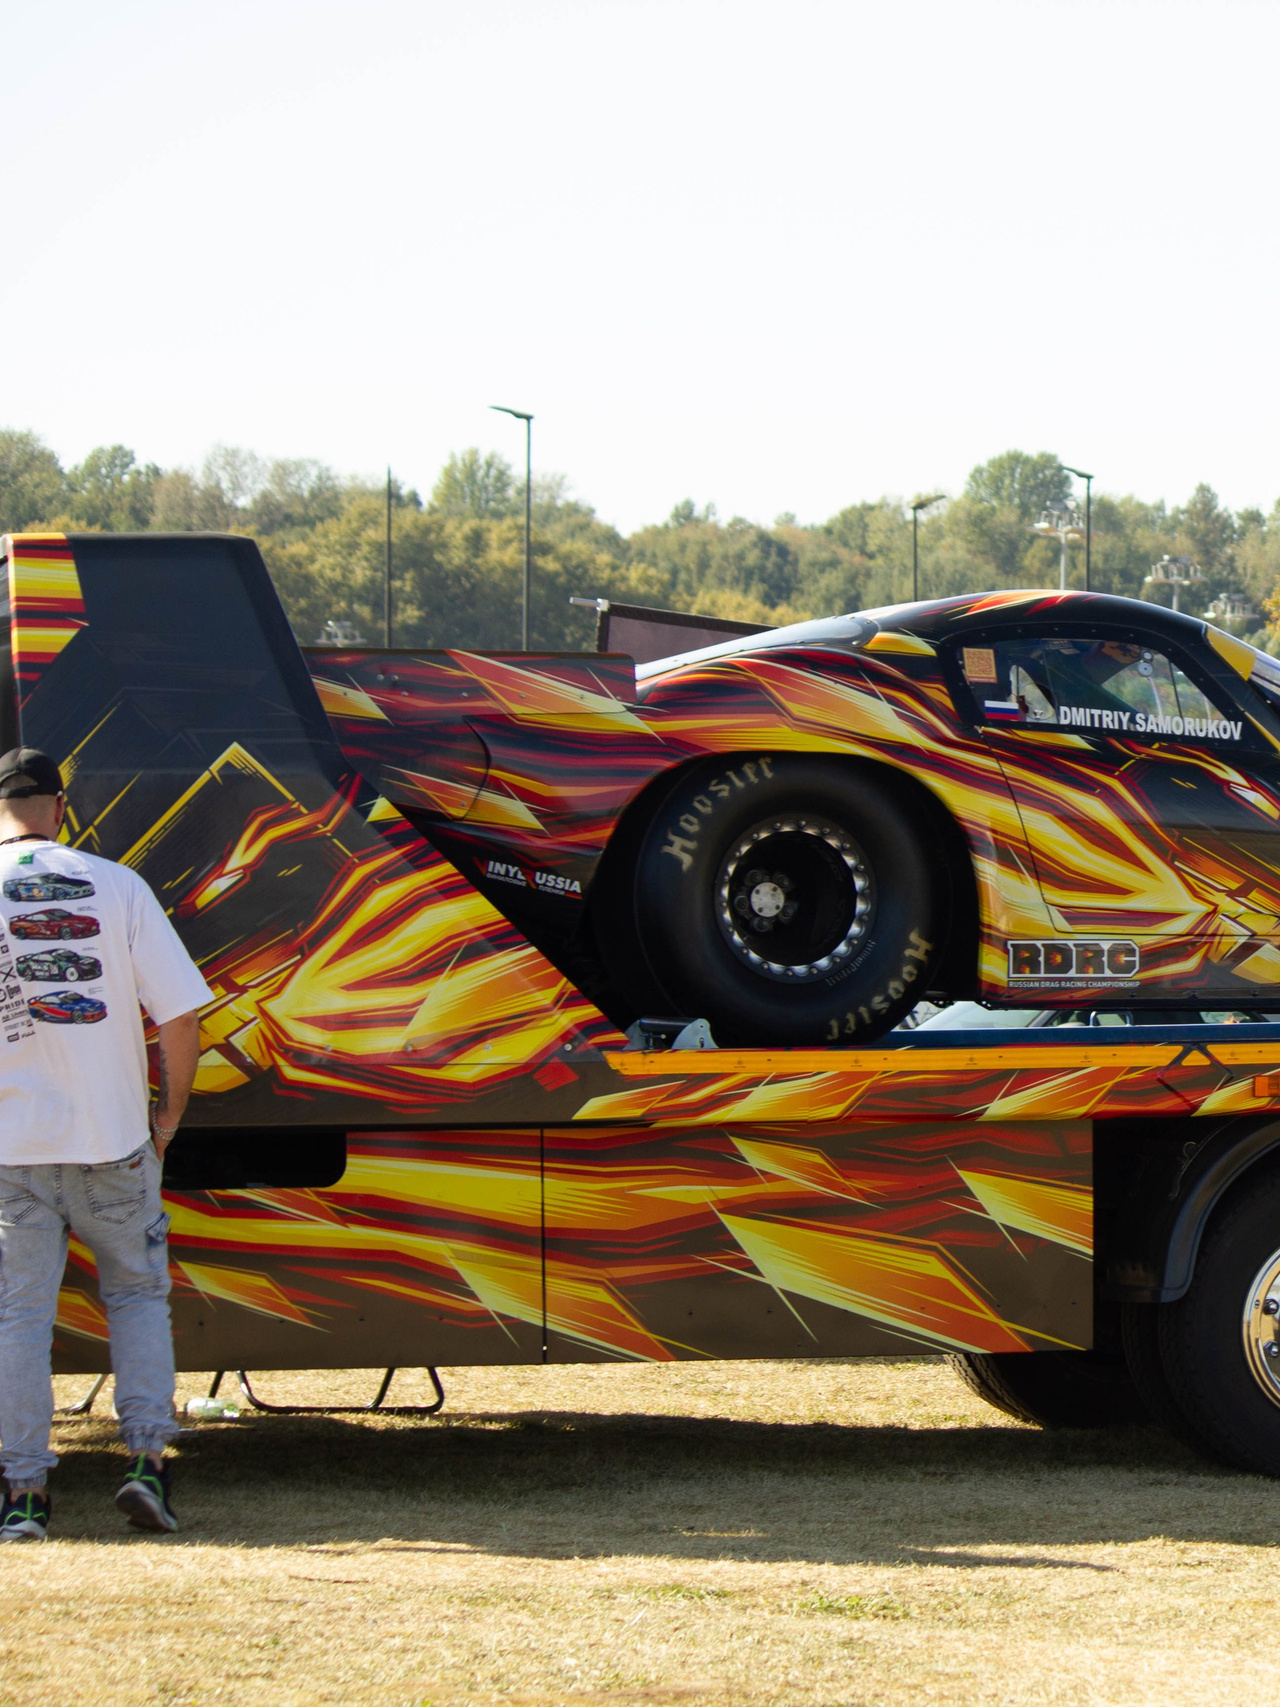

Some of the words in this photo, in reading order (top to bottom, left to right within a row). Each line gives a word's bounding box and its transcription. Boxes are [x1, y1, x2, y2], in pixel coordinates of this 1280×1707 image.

[1059, 706, 1130, 730] DMITRIY
[1135, 713, 1242, 740] SAMORUKOV
[1008, 940, 1139, 977] RDRC
